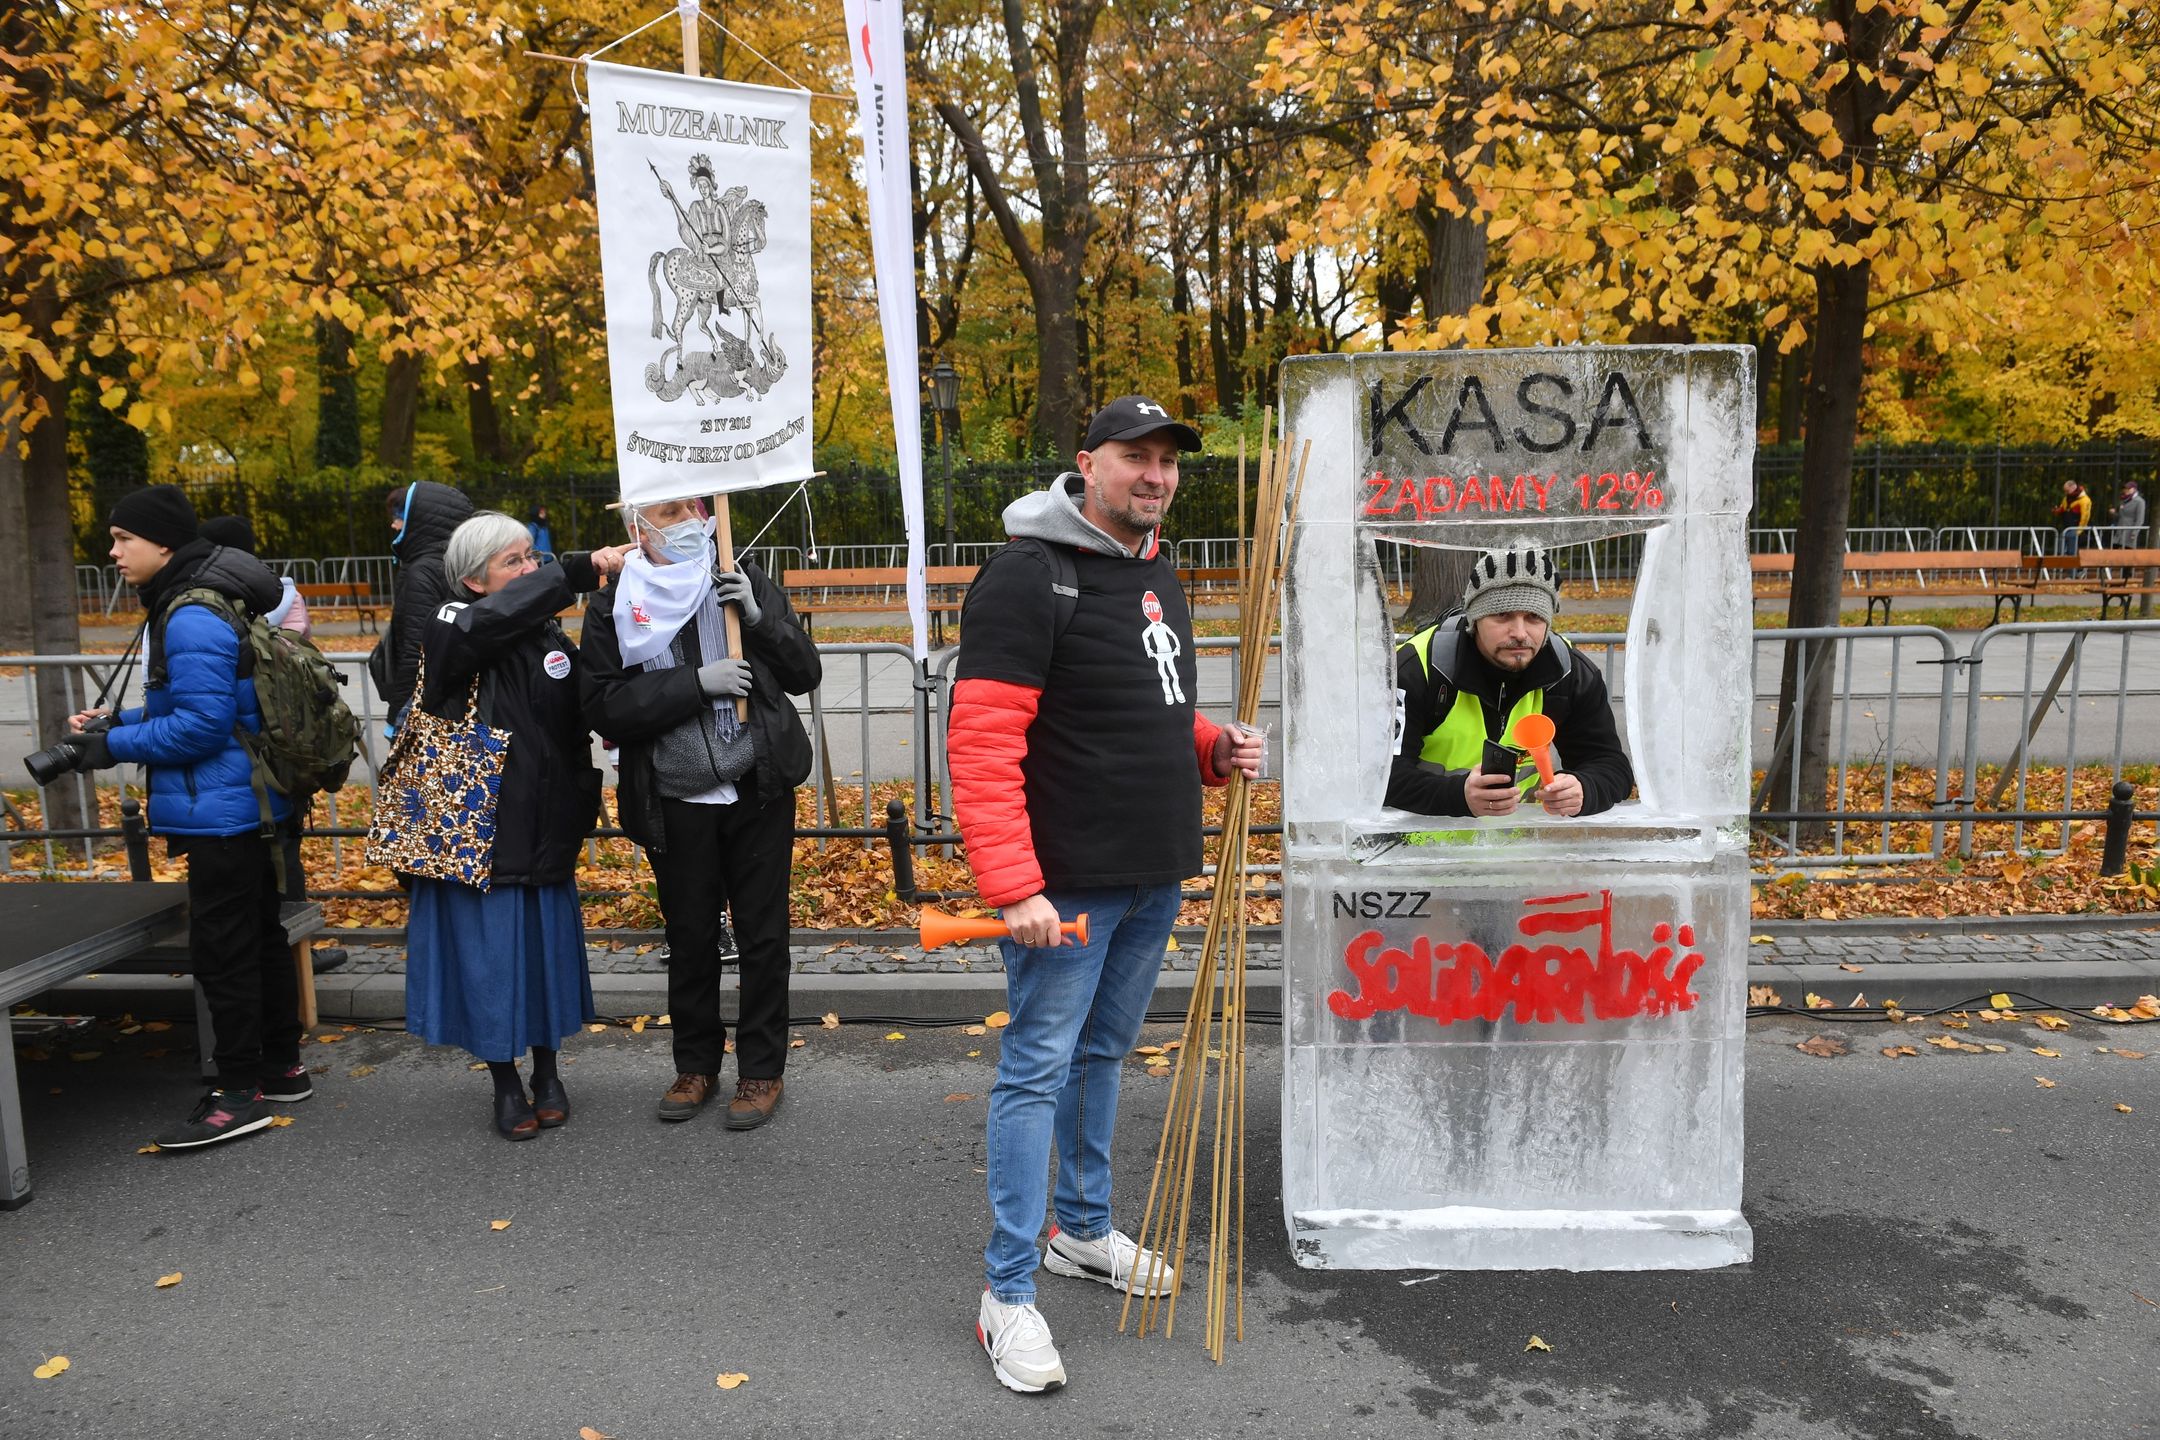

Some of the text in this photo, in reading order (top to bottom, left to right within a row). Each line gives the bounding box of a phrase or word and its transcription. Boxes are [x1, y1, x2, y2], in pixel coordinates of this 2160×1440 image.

[616, 101, 788, 149] MUZEALNIK
[700, 416, 751, 433] 23 IV 2015
[1371, 372, 1653, 456] KASA
[627, 416, 805, 463] ŚWIĘTY JERZY OD ZBIORÓW
[1364, 471, 1663, 521] ŻĄDAMY 12%
[1144, 601, 1160, 613] STOP
[1333, 891, 1431, 919] NSZZ
